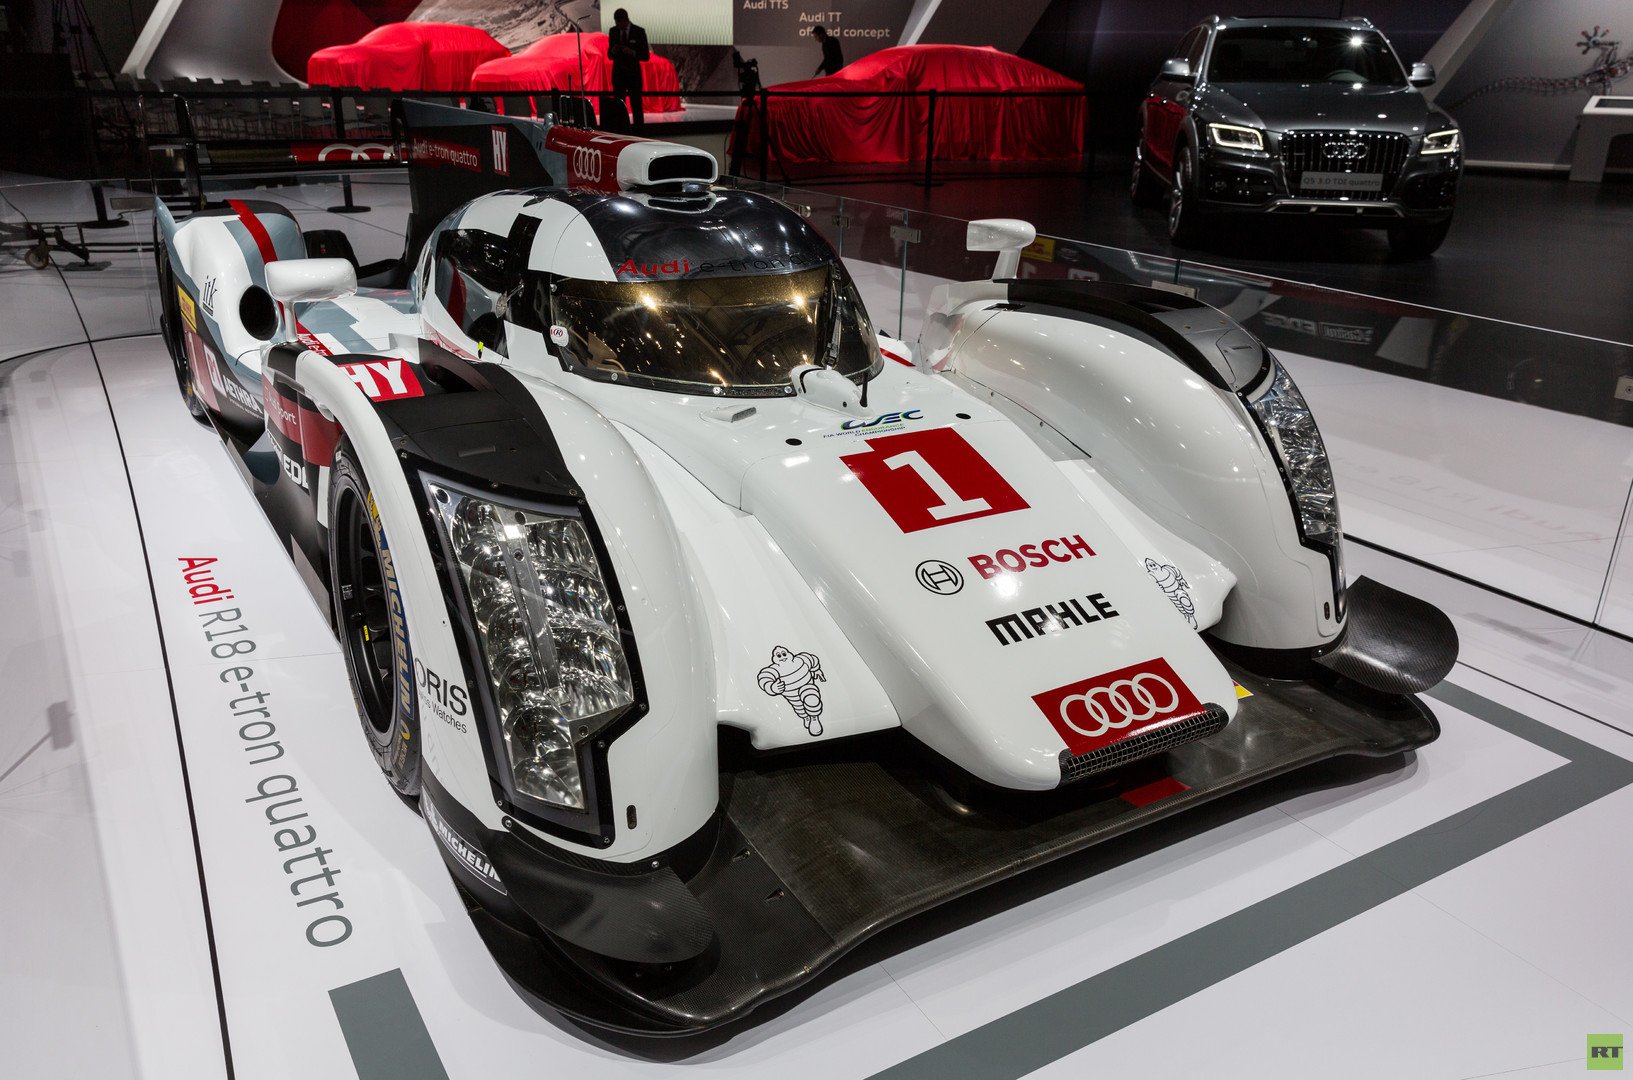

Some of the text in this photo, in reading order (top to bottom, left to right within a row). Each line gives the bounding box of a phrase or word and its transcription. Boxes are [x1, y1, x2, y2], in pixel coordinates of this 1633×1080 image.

[743, 0, 789, 10] Audi TTS
[799, 12, 842, 23] Audi TT
[843, 27, 891, 40] concept
[449, 149, 478, 168] quattro
[491, 128, 508, 173] HY
[1348, 178, 1381, 187] quattro
[615, 257, 691, 276] Audi
[698, 256, 785, 273] e-tron
[340, 359, 408, 398] HY
[882, 449, 993, 521] 1
[967, 534, 1097, 580] BOSCH
[381, 548, 412, 715] MICHELIN
[985, 592, 1120, 647] MAHLE
[414, 657, 468, 716] ORIS
[431, 700, 468, 734] Watches
[177, 557, 353, 948] Audi R18 e-tron quattro
[438, 820, 502, 882] MICHELIN
